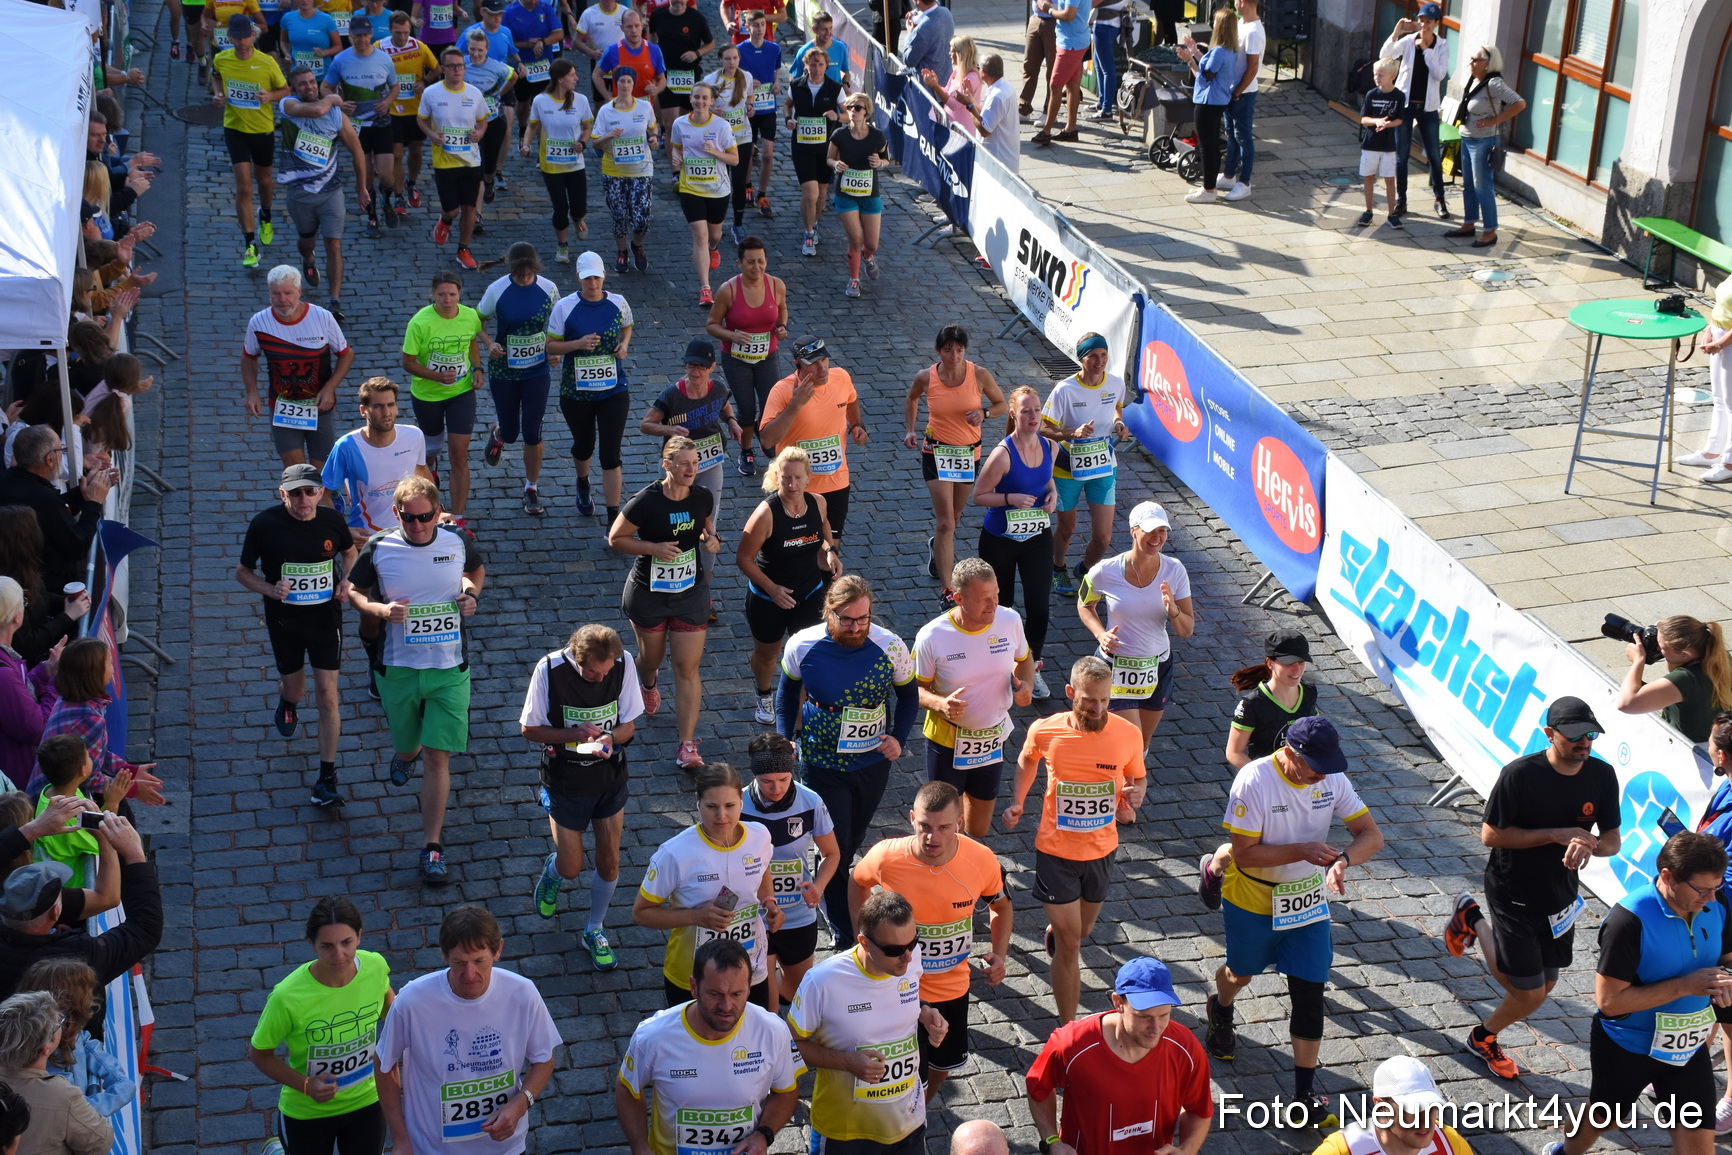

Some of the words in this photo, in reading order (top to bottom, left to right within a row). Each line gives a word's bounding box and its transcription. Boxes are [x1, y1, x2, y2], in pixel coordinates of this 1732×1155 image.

[670, 77, 692, 85] 1036
[230, 89, 256, 100] 2632
[800, 126, 823, 135] 1038
[445, 136, 469, 145] 2218
[299, 142, 325, 157] 2494
[550, 147, 574, 156] 2219
[617, 146, 641, 156] 2313
[689, 166, 713, 175] 1037
[845, 178, 869, 188] 1066
[1017, 228, 1067, 298] swn
[512, 346, 540, 358] 2604
[433, 354, 463, 363] BOCK
[579, 358, 612, 366] BOCK
[580, 367, 613, 380] 2596
[1143, 347, 1199, 428] Hervis
[279, 403, 311, 418] 2321
[1207, 399, 1231, 422] STORE
[282, 418, 308, 426] STEFAN
[801, 438, 836, 449] BOCK
[1214, 424, 1236, 452] ONLINE
[697, 445, 719, 462] 316
[938, 447, 971, 456] BOCK
[1073, 443, 1105, 453] BOCK
[698, 459, 718, 469] AUDIA
[939, 458, 970, 470] 2153
[1075, 453, 1108, 469] 2819
[1213, 451, 1235, 480] MOBILE
[1256, 441, 1316, 539] Hervis
[669, 511, 691, 525] RUN
[1012, 510, 1044, 520] BOCK
[1263, 500, 1288, 529] SPORTS
[287, 563, 328, 574] BOCK
[657, 564, 692, 580] 2174
[288, 576, 328, 591] 2619
[409, 604, 452, 616] BOCK
[410, 616, 454, 634] 2526
[410, 633, 455, 643] CHRISTIAN
[1118, 658, 1154, 668] BOCK
[1118, 670, 1154, 686] 1076
[569, 704, 612, 719] BOCK
[846, 721, 883, 738] 2601
[961, 738, 1000, 755] 2356
[966, 754, 992, 765] GEORG
[1061, 783, 1110, 795] BOCK
[1063, 799, 1110, 815] 2536
[1067, 818, 1105, 827] MARKUS
[743, 856, 754, 865] 20
[770, 861, 797, 873] CK
[773, 877, 796, 892] 69
[1279, 876, 1322, 894] BOCK
[776, 896, 796, 904] TINA
[1280, 888, 1322, 914] 3005
[1279, 907, 1323, 925] WOLFGANG
[919, 921, 965, 936] BOCK
[920, 936, 966, 957] 2537
[922, 957, 958, 969] MARCO
[899, 981, 909, 991] 20
[848, 1003, 872, 1012] BOCK
[1663, 1010, 1710, 1029] BOCK
[314, 1036, 371, 1058] BOCK
[471, 1040, 501, 1051] 16.09.2007
[878, 1040, 914, 1059] OCK
[733, 1049, 747, 1061] 20
[315, 1050, 368, 1076] 2802
[447, 1063, 459, 1072] 8.
[460, 1057, 503, 1069] Neumarkter
[470, 1062, 503, 1073] Stadtlauf
[733, 1058, 765, 1068] Neumarkter
[670, 1069, 697, 1077] BOCK
[733, 1065, 760, 1076] Stadtlauf
[869, 1057, 914, 1085] 205
[447, 1075, 507, 1097] BOCK
[866, 1082, 909, 1098] MICHAEL
[451, 1093, 509, 1122] 2839
[683, 1107, 745, 1123] BOCK
[685, 1126, 745, 1146] 2342
[1123, 1126, 1142, 1136] DEHN
